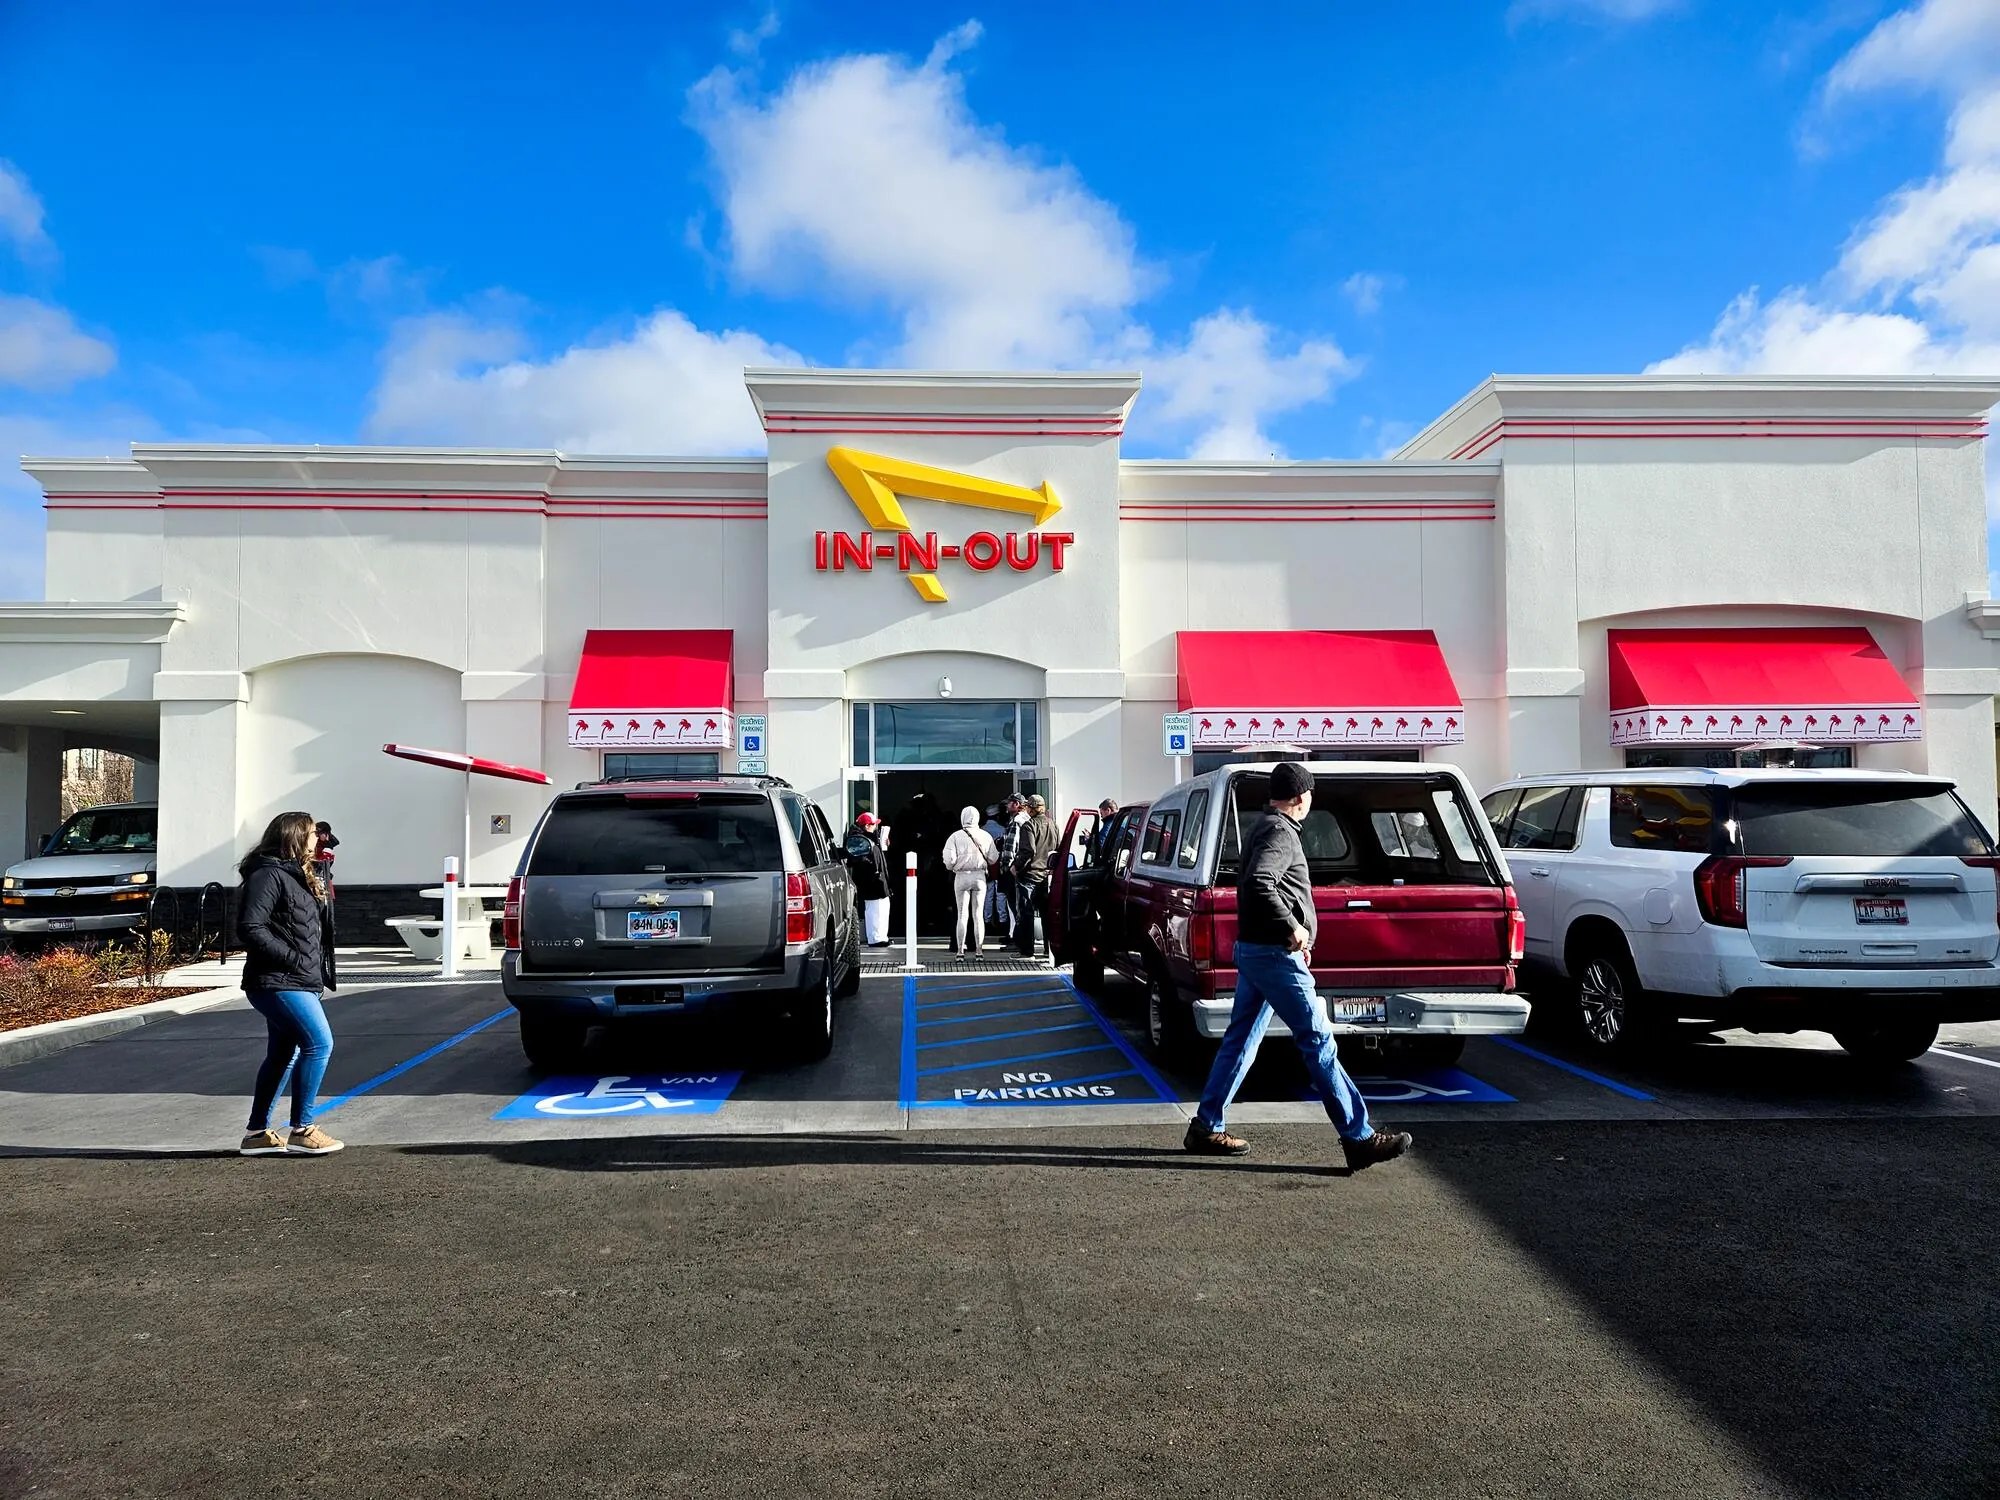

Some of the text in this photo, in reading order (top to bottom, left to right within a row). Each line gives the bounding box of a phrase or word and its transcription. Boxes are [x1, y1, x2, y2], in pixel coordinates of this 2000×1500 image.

[815, 531, 1074, 572] IN-N-OUT
[633, 918, 675, 931] 34N 063
[661, 1076, 718, 1084] VAN
[1003, 1072, 1052, 1084] NO
[954, 1085, 1115, 1100] PARKING
